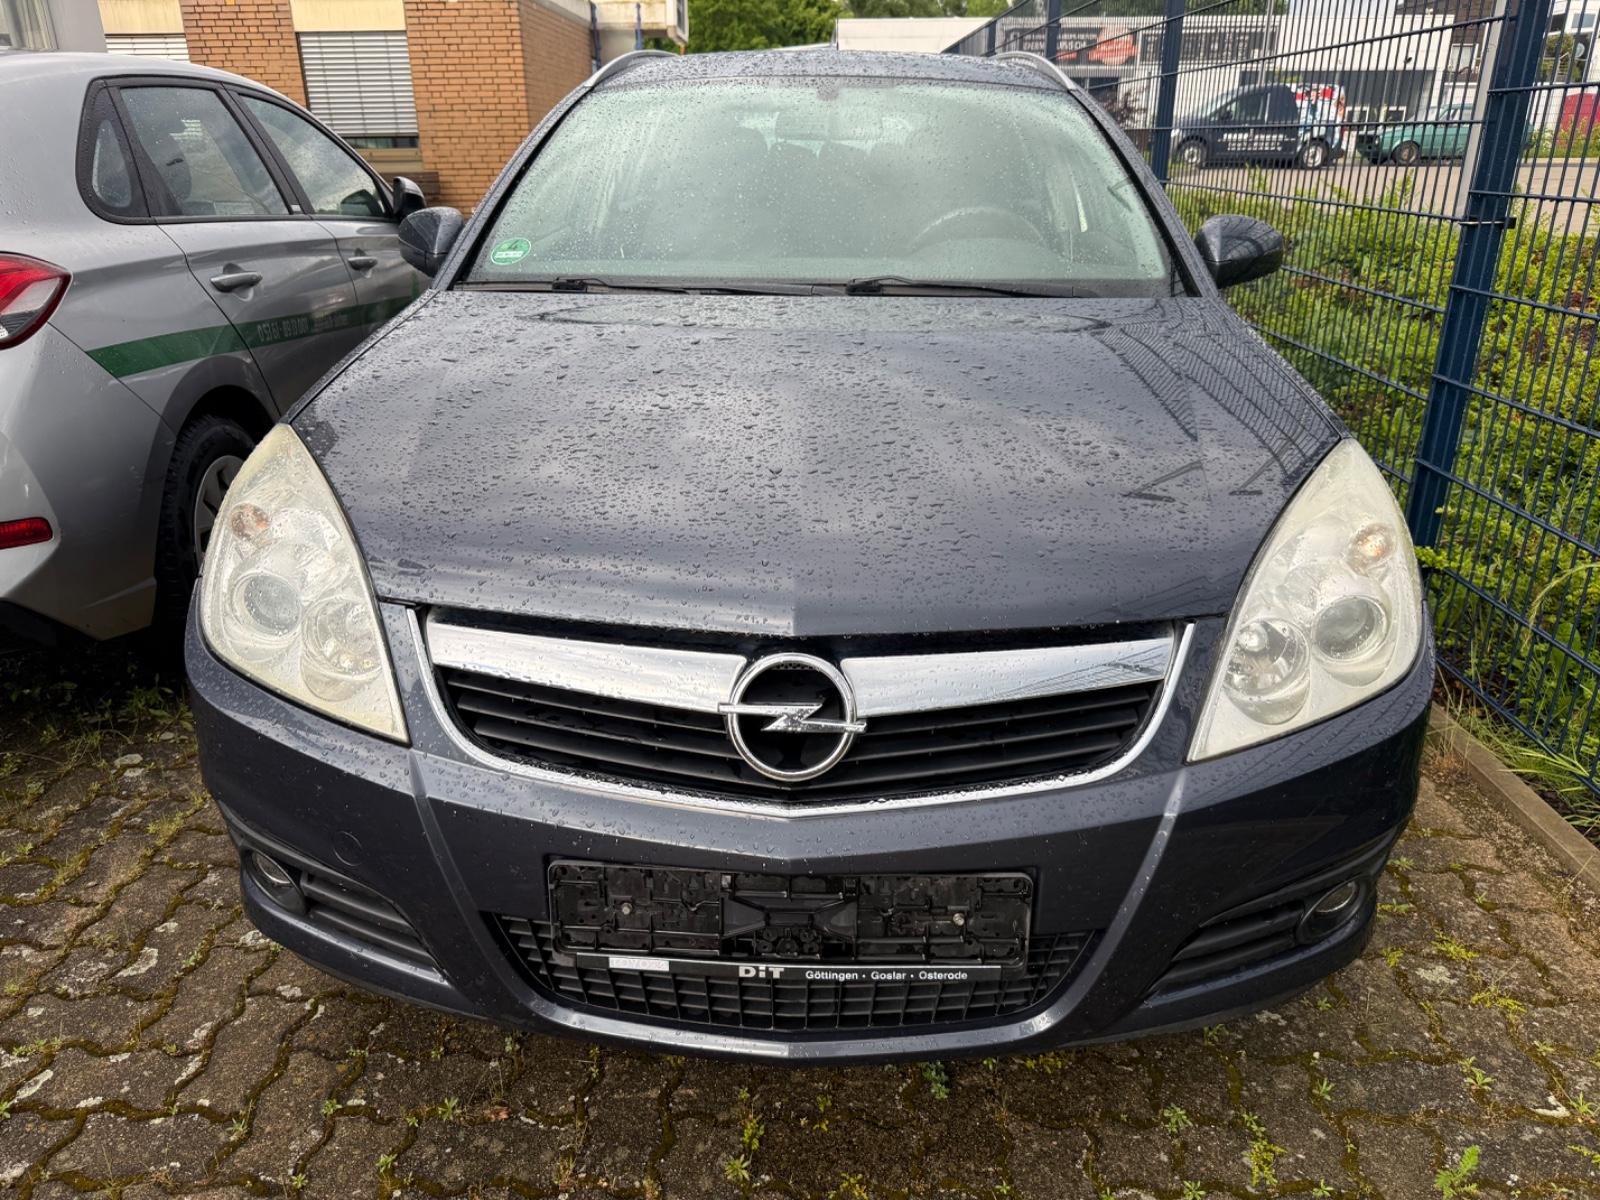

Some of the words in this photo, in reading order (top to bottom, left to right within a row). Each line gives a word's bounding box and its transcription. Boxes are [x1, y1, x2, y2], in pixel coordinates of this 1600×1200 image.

[738, 966, 785, 979] DiT
[805, 970, 858, 981] Göttingen
[871, 970, 906, 980] Goslar
[919, 970, 968, 981] Osterode
